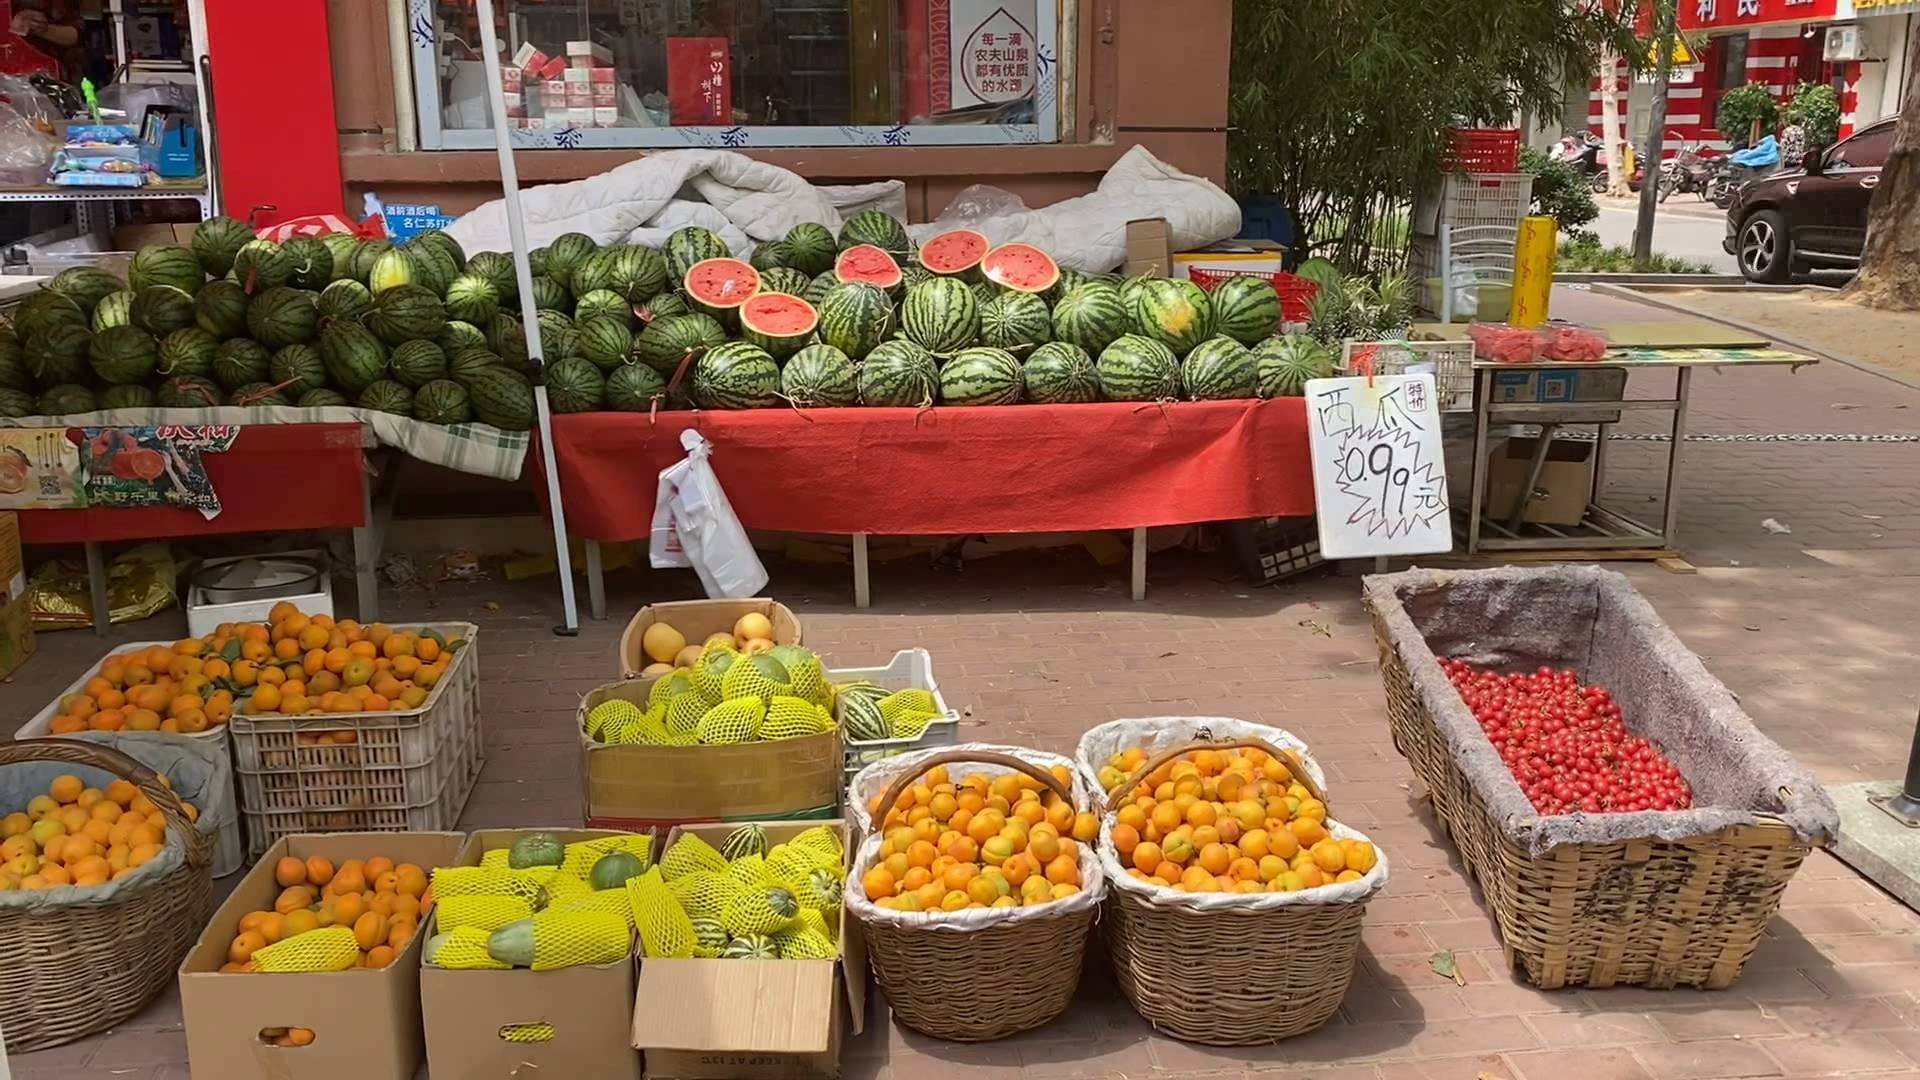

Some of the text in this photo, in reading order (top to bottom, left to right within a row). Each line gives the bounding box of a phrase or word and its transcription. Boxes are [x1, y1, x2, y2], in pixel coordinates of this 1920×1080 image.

[1696, 0, 1814, 22] 利民
[981, 33, 1022, 46] 每一滴
[975, 48, 1029, 61] 农夫山泉
[976, 63, 1029, 77] 都有优质
[982, 79, 1022, 93] 的水源
[1408, 383, 1426, 410] 特价
[1318, 387, 1425, 437] 西瓜
